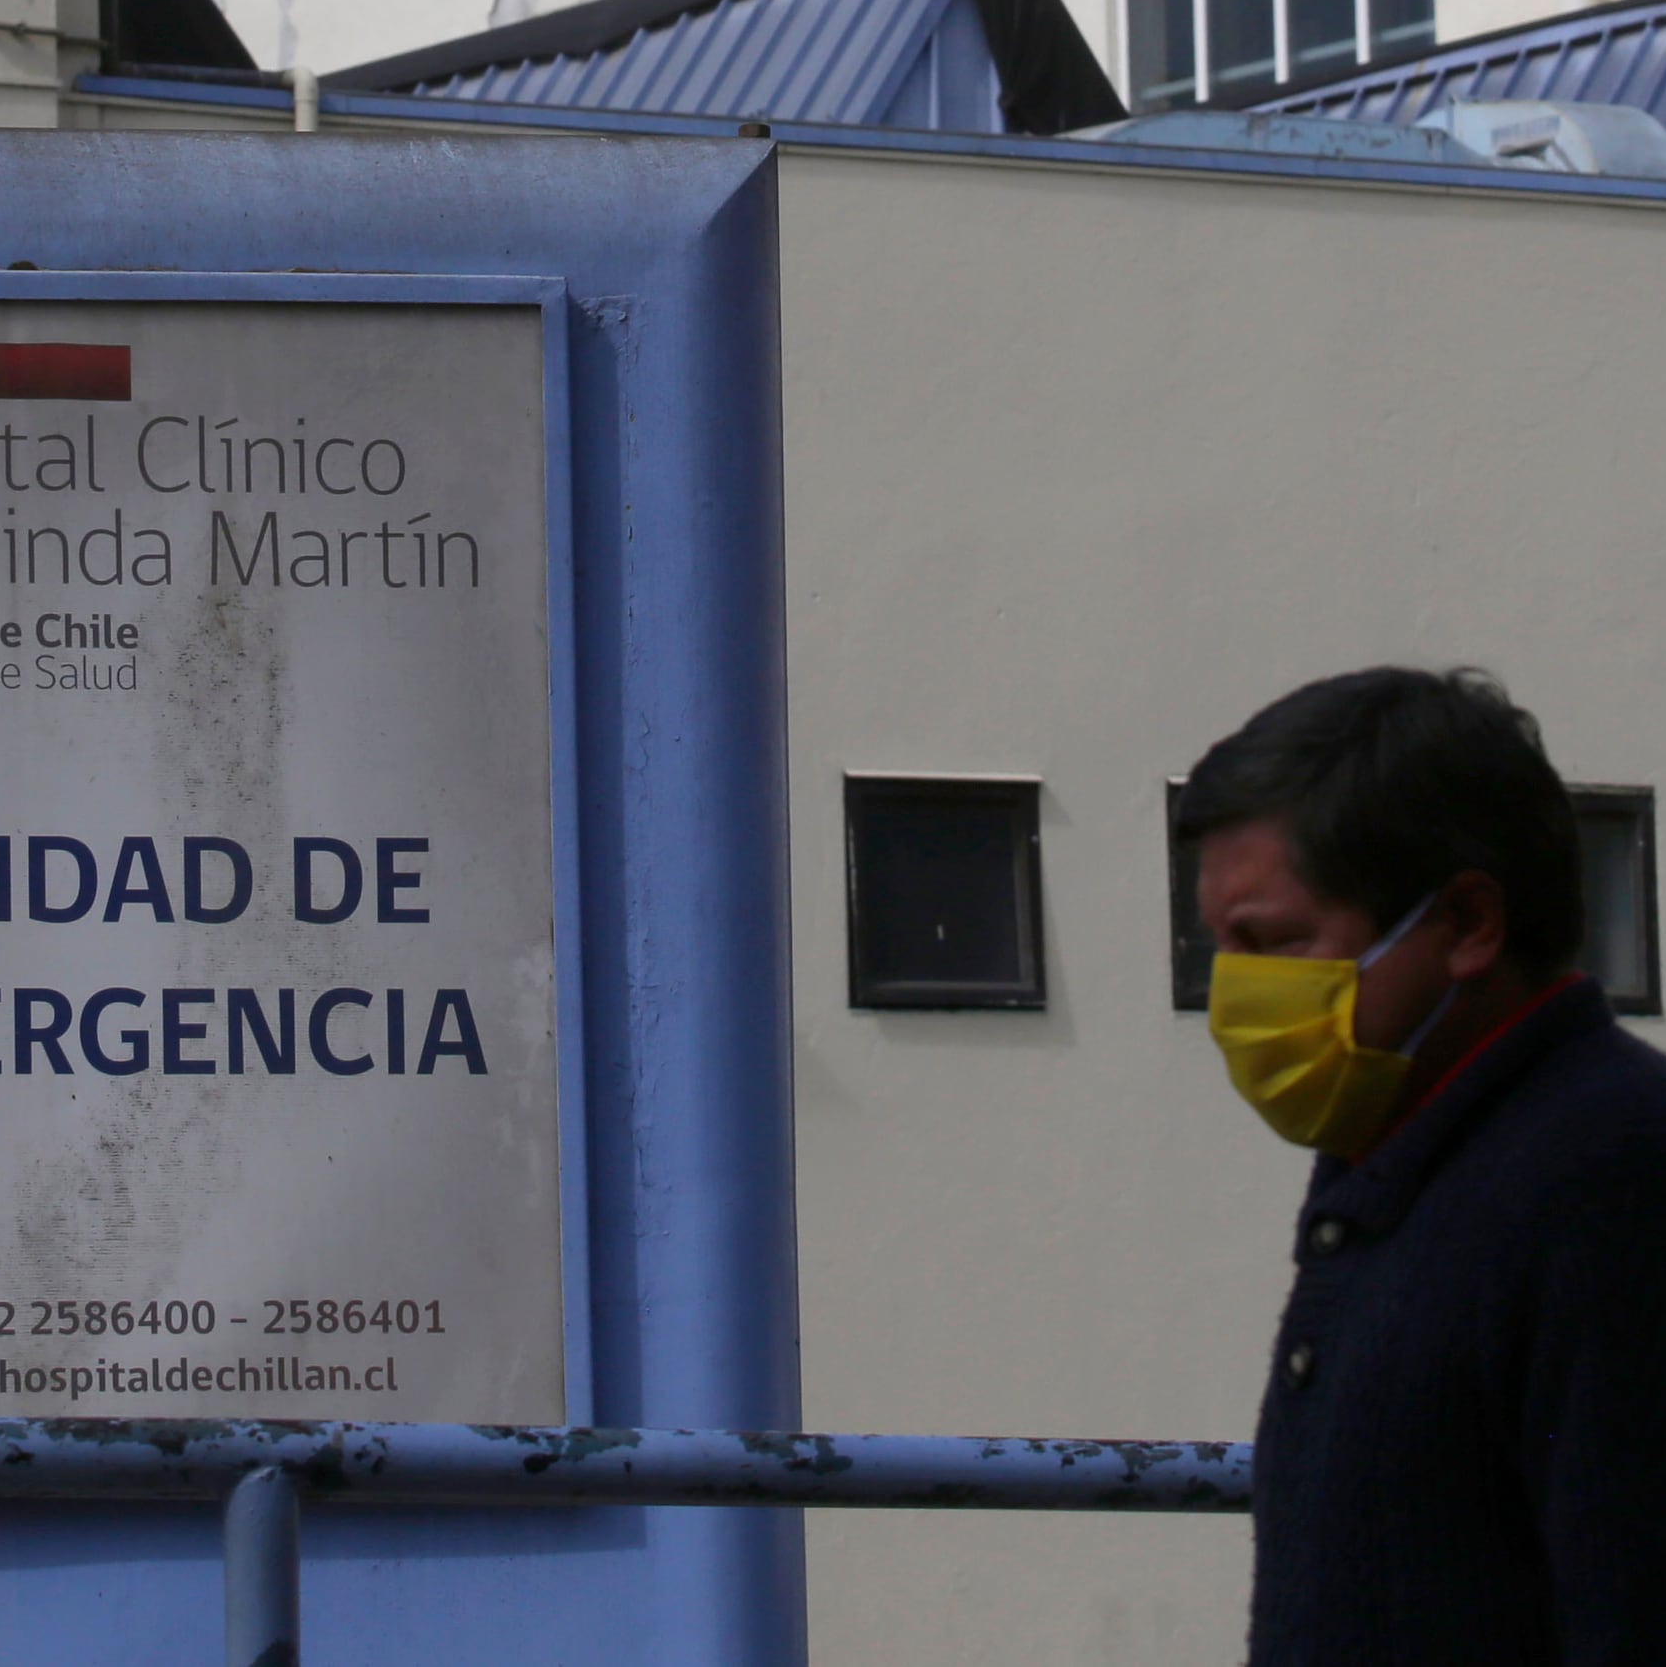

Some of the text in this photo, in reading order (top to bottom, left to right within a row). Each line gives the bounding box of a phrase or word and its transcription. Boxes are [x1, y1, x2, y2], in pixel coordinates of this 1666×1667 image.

[137, 414, 406, 496] Clínico
[210, 510, 479, 589] Martín
[35, 613, 139, 650] Chile
[35, 654, 137, 691] Salud
[293, 836, 430, 925] DE
[30, 1300, 216, 1336] 2586400
[263, 1299, 446, 1335] 2586401
